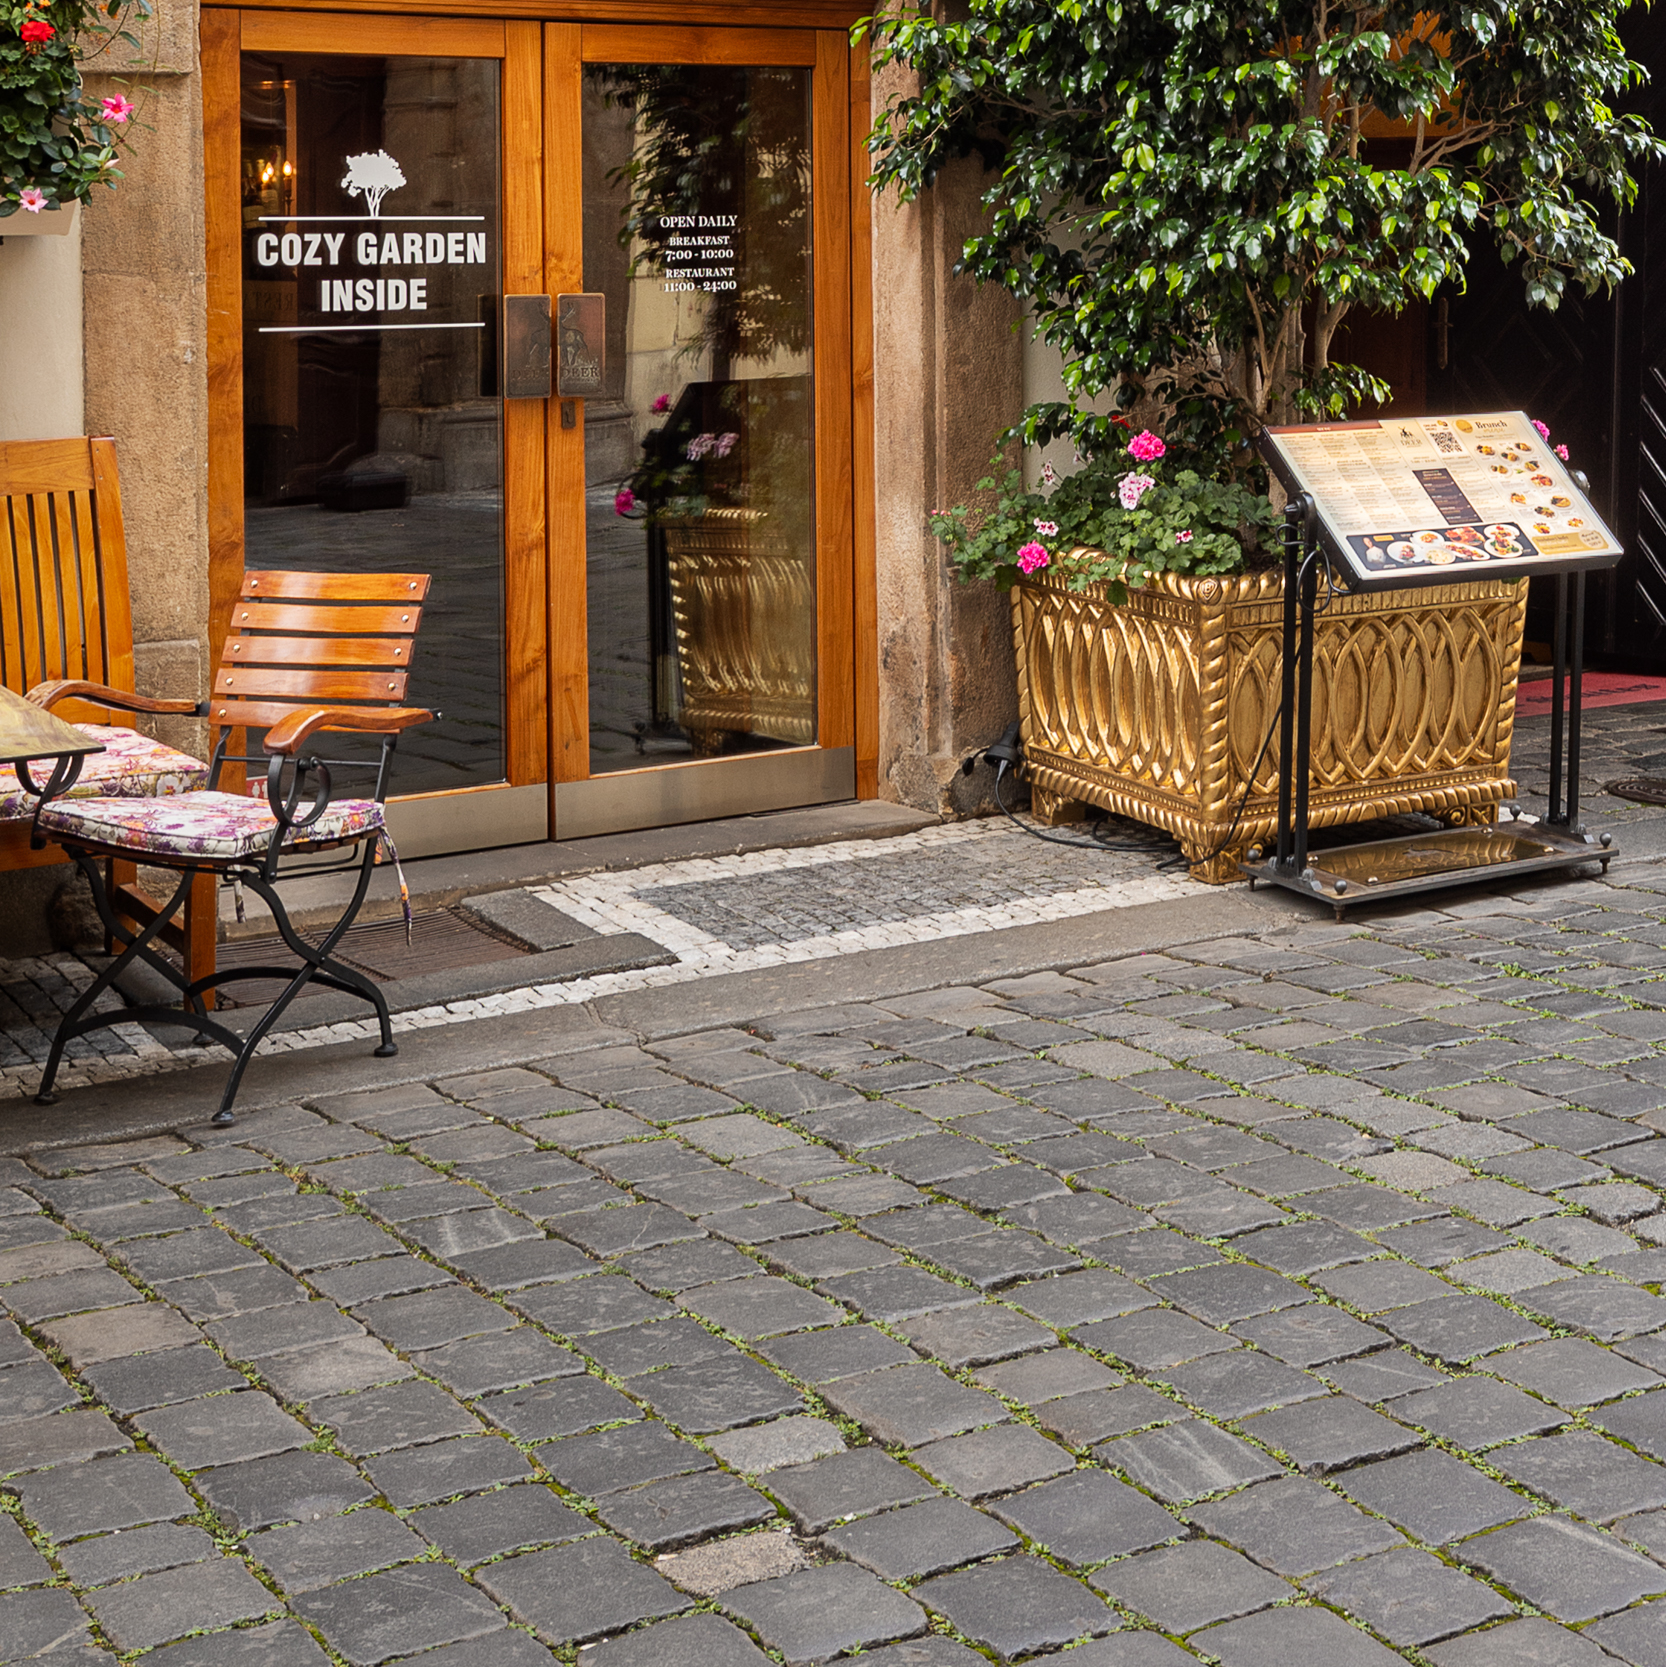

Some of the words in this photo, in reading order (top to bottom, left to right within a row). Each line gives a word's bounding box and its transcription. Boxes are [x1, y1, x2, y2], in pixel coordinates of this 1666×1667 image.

[660, 215, 696, 228] OPEN
[698, 214, 738, 227] DAILY
[669, 235, 730, 247] BREAKFAST
[257, 232, 346, 267] COZY
[356, 231, 487, 266] GARDEN
[665, 249, 693, 263] 7:00
[701, 248, 734, 260] 10:00
[665, 267, 735, 279] RESTAURANT
[664, 282, 695, 293] 11:00
[703, 280, 737, 293] 24:00
[321, 278, 428, 313] INSIDE
[561, 367, 600, 379] DEER
[1475, 420, 1508, 430] Brunch
